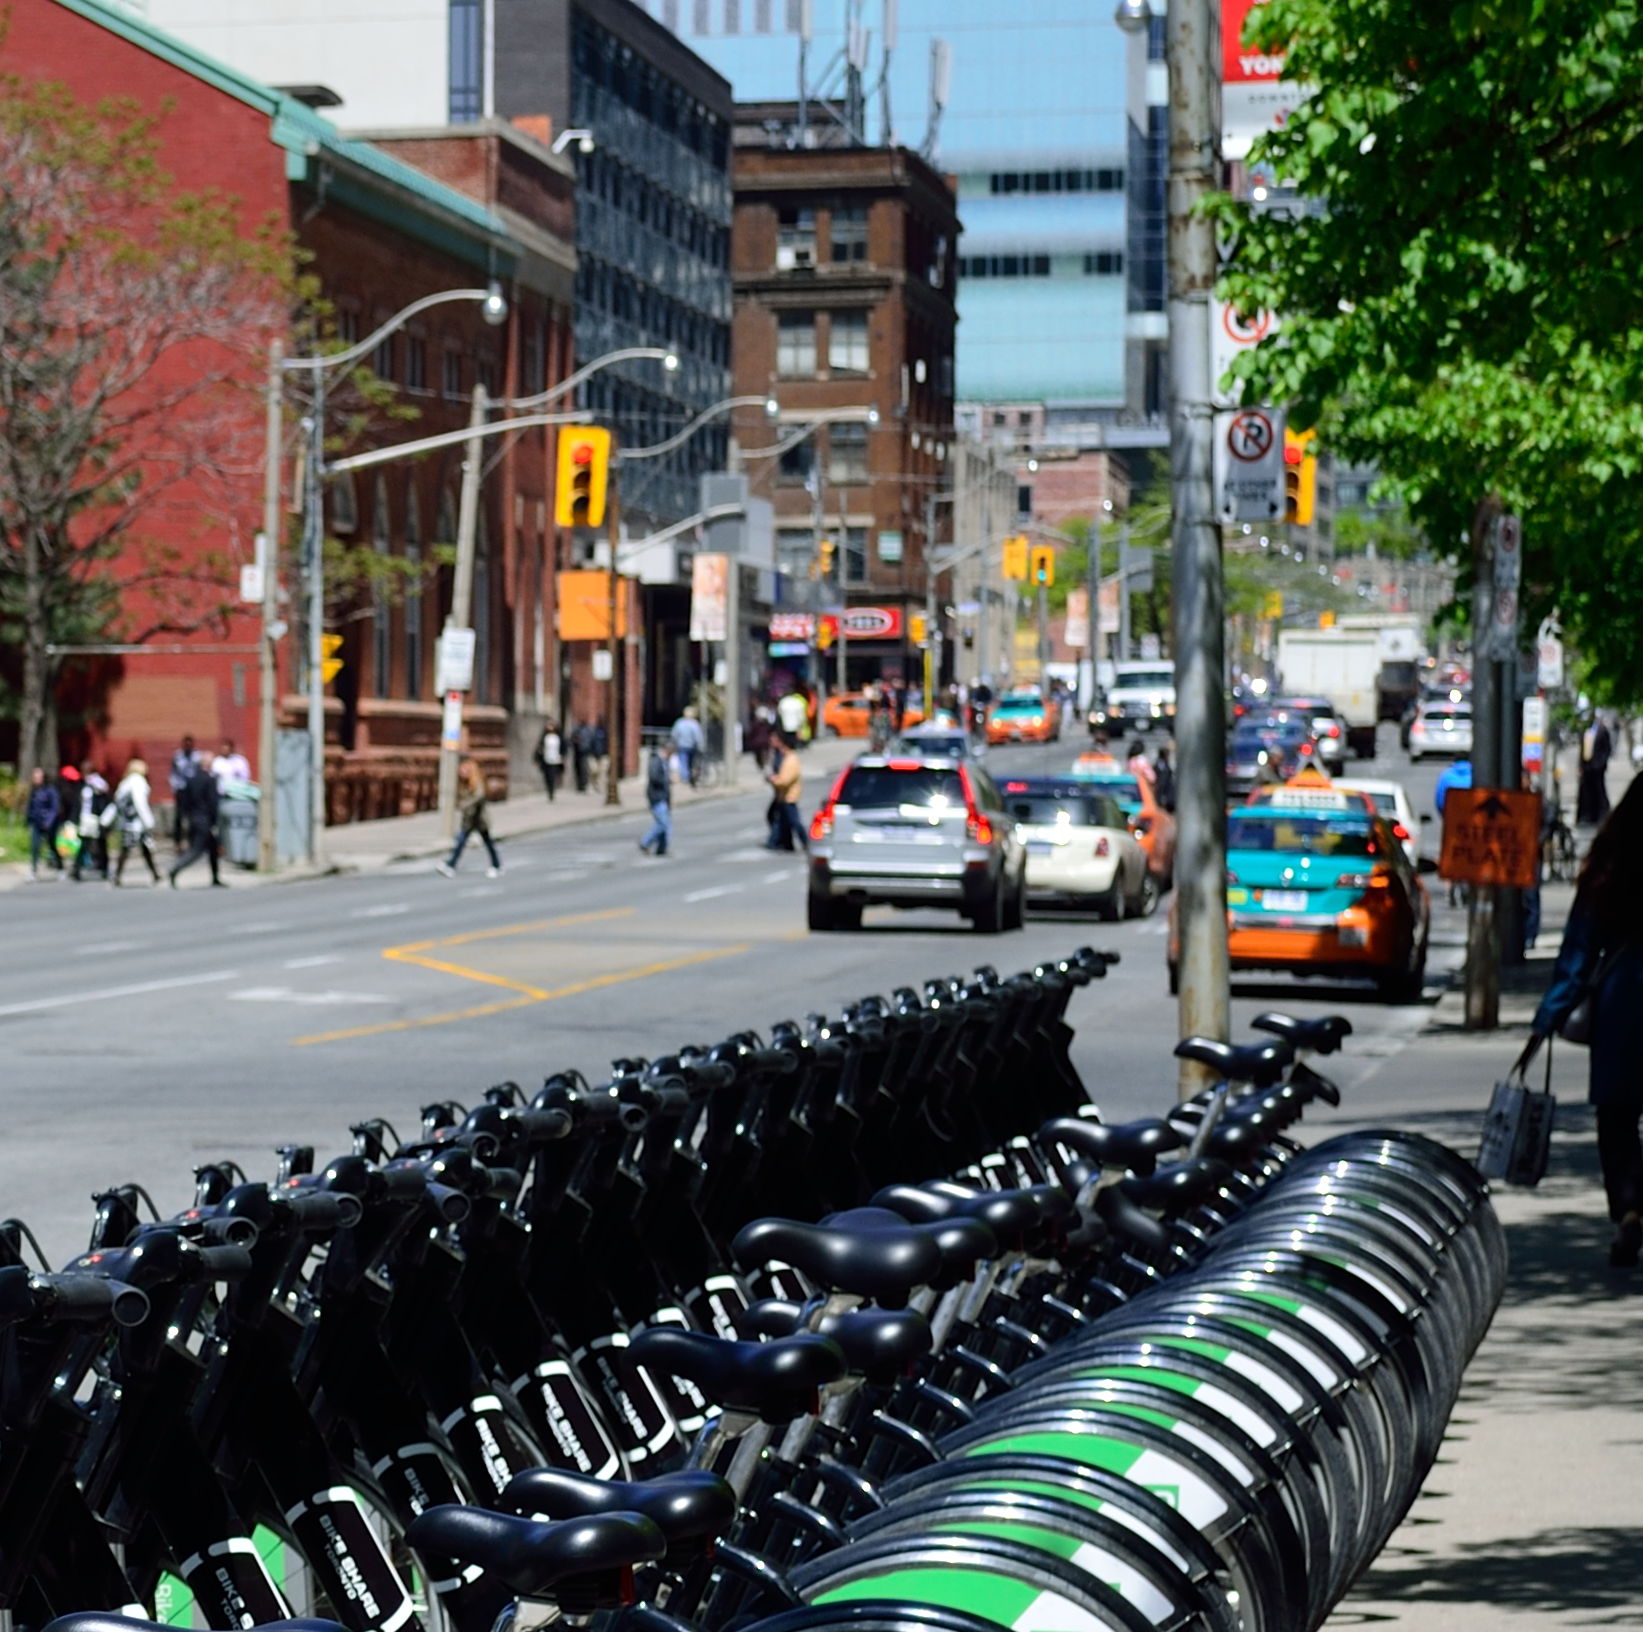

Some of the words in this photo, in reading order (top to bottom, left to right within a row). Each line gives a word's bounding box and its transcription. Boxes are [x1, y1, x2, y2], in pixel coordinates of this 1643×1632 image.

[1239, 56, 1284, 76] YON
[475, 1417, 501, 1458] BIKE
[404, 1467, 430, 1506] BIKE
[319, 1514, 347, 1555] BIKE
[340, 1556, 381, 1619] SHARE
[216, 1567, 246, 1609] BIKE
